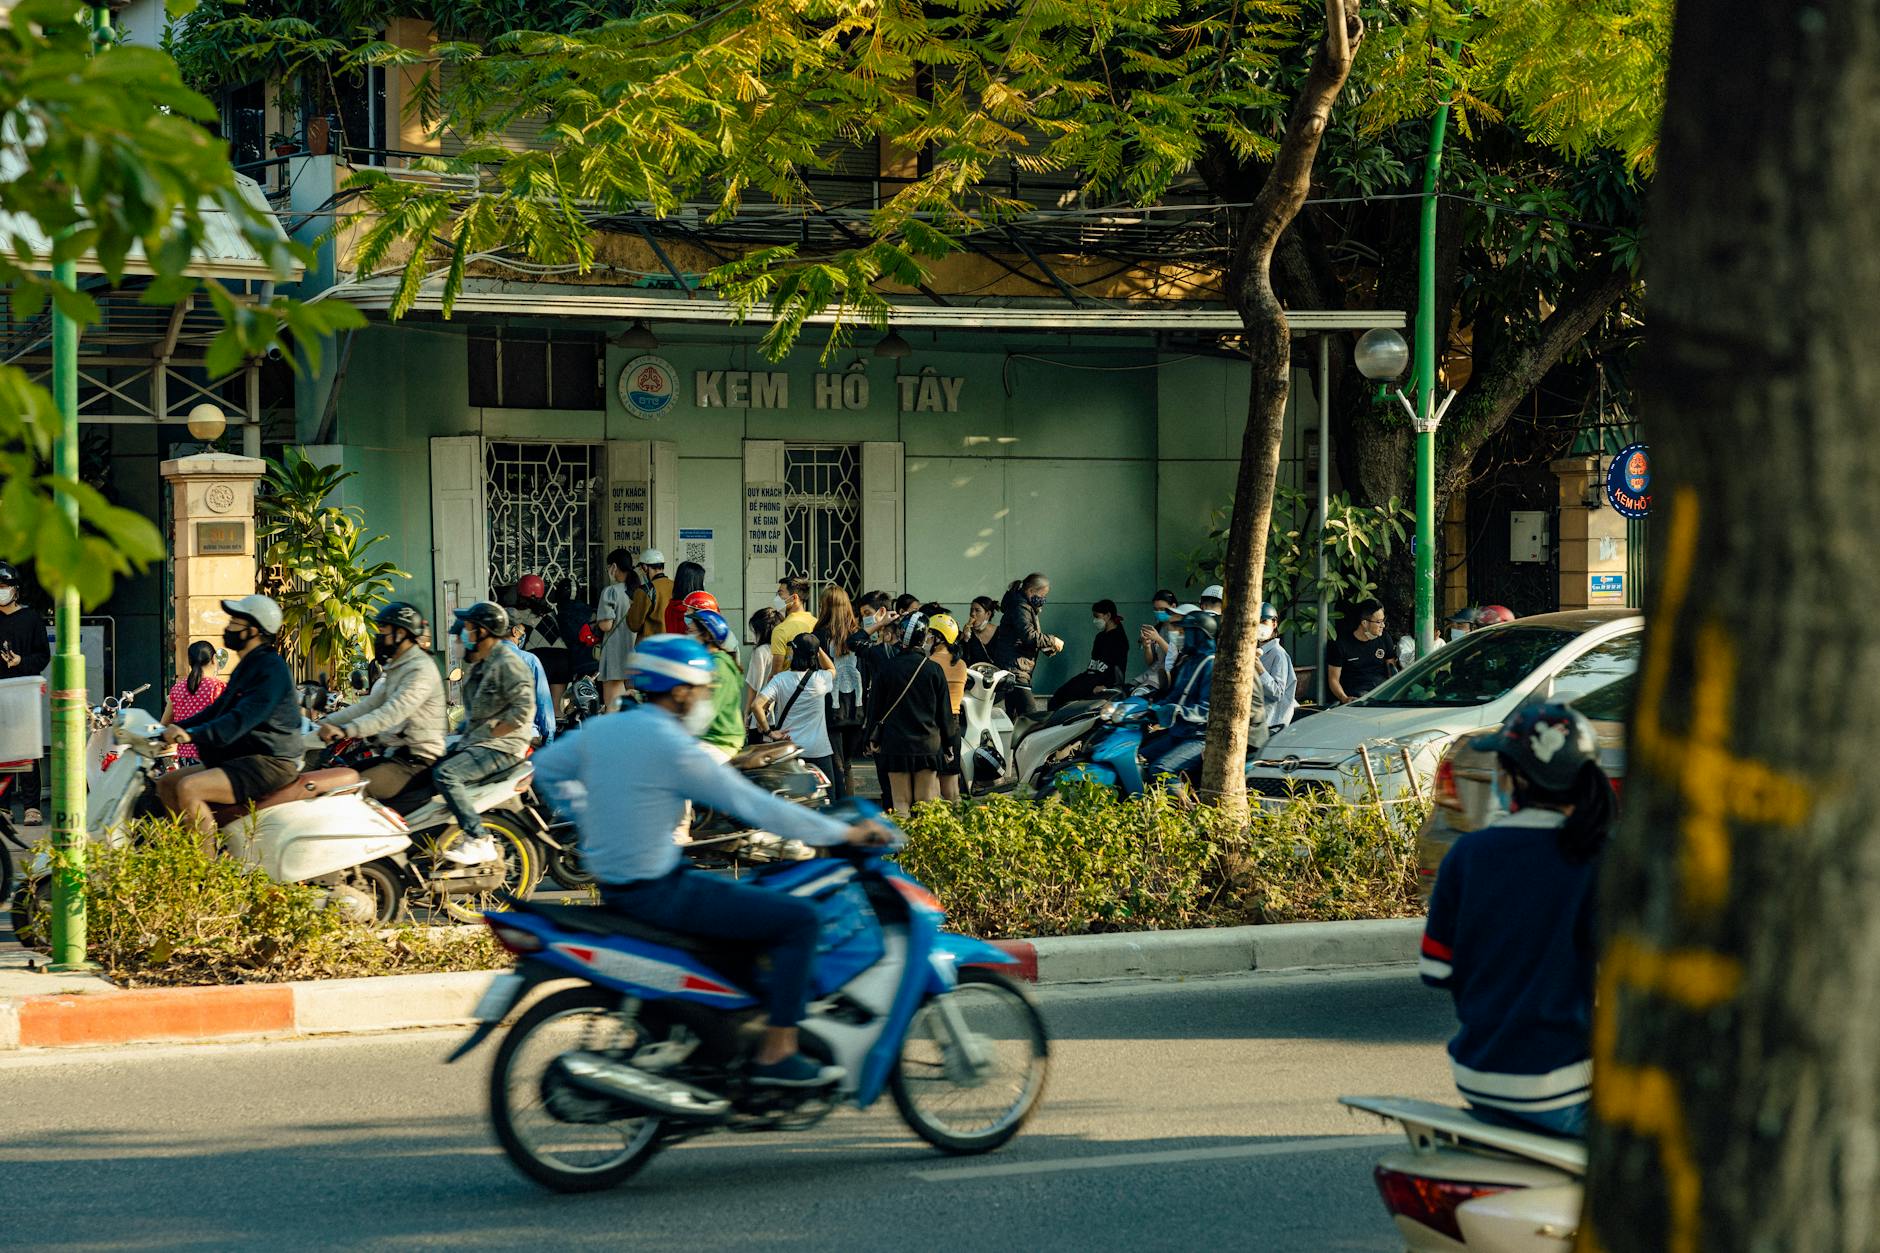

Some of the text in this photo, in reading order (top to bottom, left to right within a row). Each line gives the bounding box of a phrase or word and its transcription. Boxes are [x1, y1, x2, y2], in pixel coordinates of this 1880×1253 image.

[696, 370, 789, 409] KEM
[816, 357, 870, 410] HỒ
[897, 366, 964, 412] TÂY
[625, 485, 647, 497] KHÁCH
[747, 485, 783, 498] QUÝ KHÁCH
[1614, 487, 1634, 510] KEM
[1634, 495, 1647, 511] HỒ
[623, 500, 645, 512] PHÒNG
[759, 500, 781, 512] PHÒNG
[627, 516, 642, 526] GIAN
[763, 516, 778, 526] GIAN
